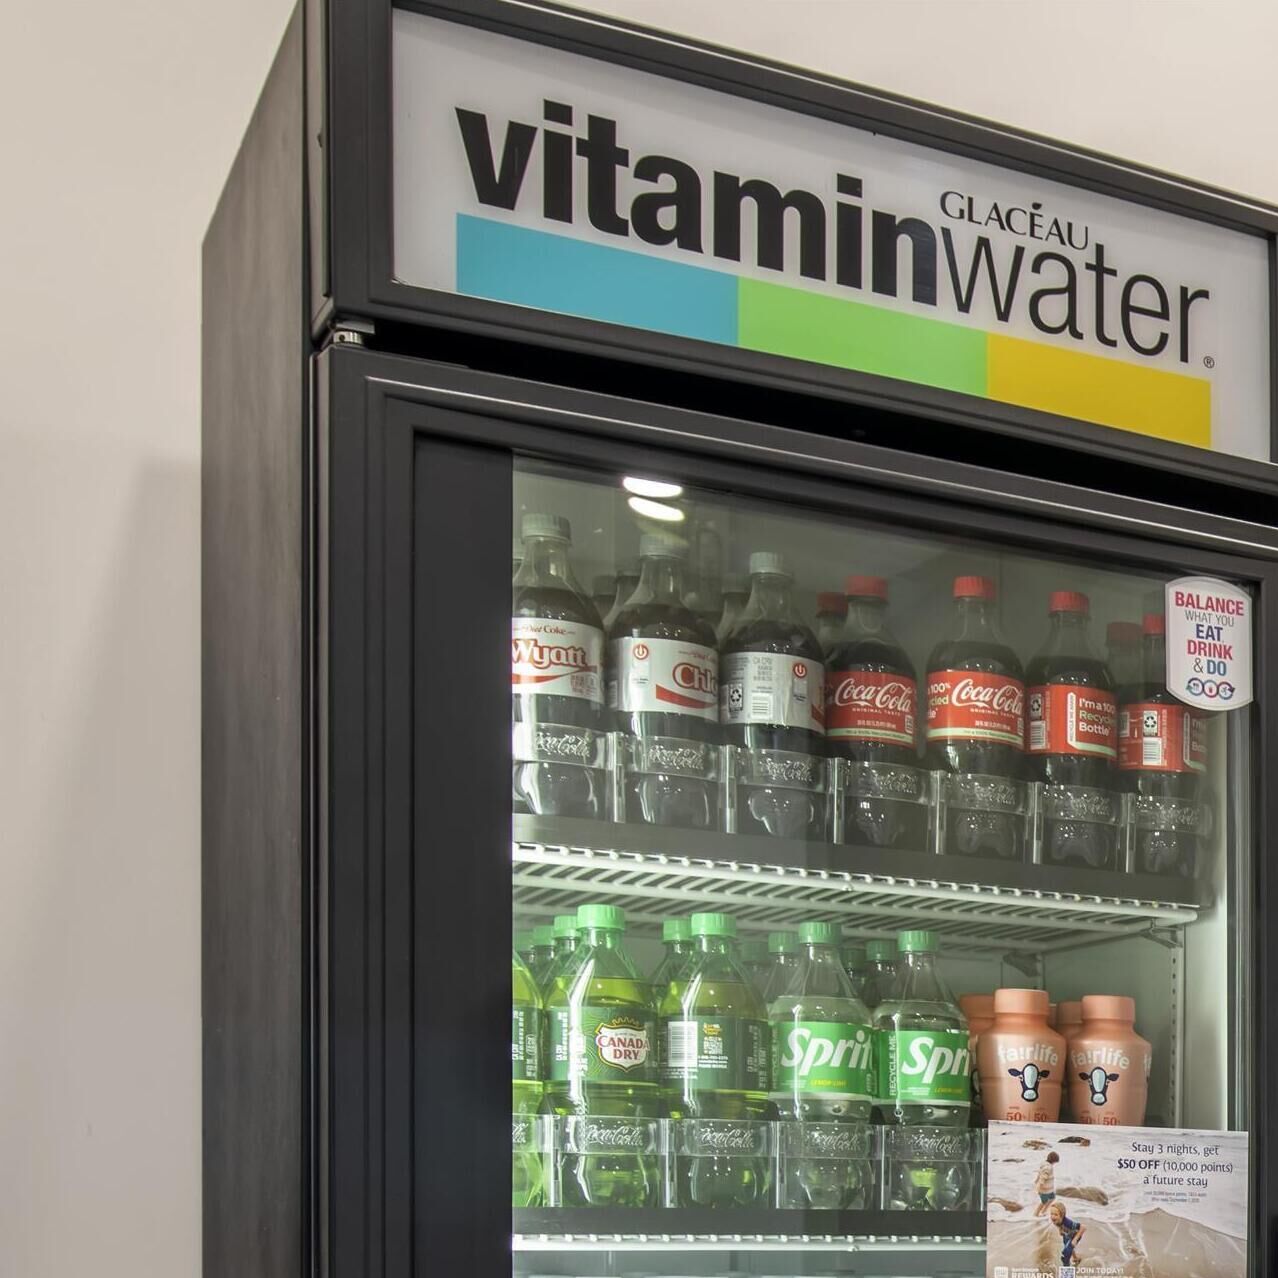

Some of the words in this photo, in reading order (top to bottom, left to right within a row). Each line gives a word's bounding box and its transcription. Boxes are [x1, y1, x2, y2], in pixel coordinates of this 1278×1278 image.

[1174, 591, 1244, 617] BALANCE
[1185, 610, 1214, 624] WHAT
[1215, 614, 1235, 627] YOU
[543, 625, 567, 636] Coke
[512, 638, 588, 669] Wyatt
[1187, 640, 1233, 660] DRINK
[1193, 658, 1204, 674] &
[1206, 660, 1227, 677] DO
[834, 678, 912, 713] Coca-Cola
[950, 678, 1022, 714] Coca-Cola
[1079, 722, 1110, 736] Bottle
[597, 1035, 650, 1051] CANADA
[612, 1048, 640, 1061] DRY
[1132, 1142, 1154, 1154] Stay
[1158, 1144, 1163, 1153] 3
[1167, 1144, 1201, 1156] nights,
[1203, 1145, 1219, 1156] get
[1117, 1159, 1135, 1170] $50
[1138, 1160, 1160, 1170] OFF
[1163, 1161, 1198, 1172] (10,000
[1201, 1161, 1233, 1173] points)
[1153, 1175, 1183, 1186] future
[1187, 1177, 1208, 1187] stay
